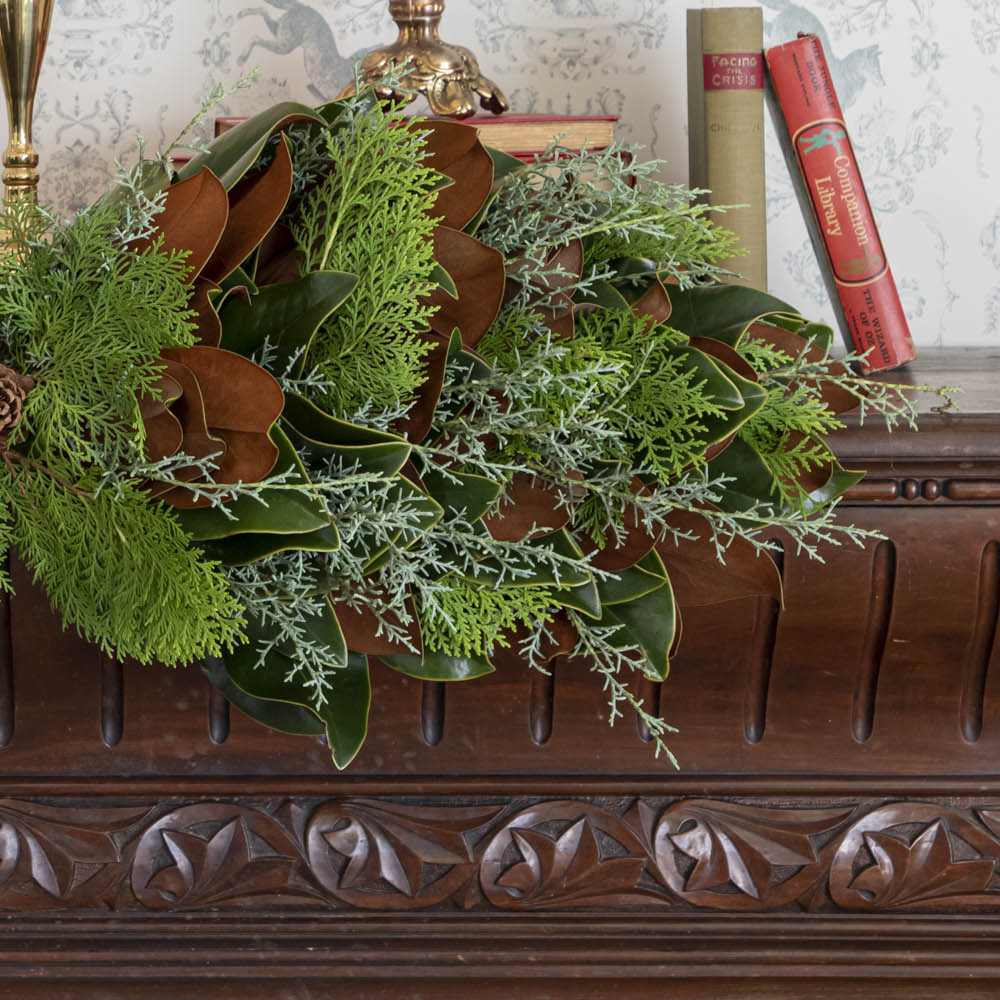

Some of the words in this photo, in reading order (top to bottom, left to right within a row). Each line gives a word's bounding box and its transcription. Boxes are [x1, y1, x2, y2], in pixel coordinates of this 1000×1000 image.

[711, 73, 757, 87] CRISIS
[806, 61, 820, 92] BOOK
[820, 65, 837, 109] JUNGLE
[814, 175, 842, 236] Library
[834, 155, 869, 247] Companion
[859, 311, 870, 327] OF
[865, 331, 876, 346] OZ
[863, 288, 876, 313] THE
[872, 317, 891, 363] WIZARD
